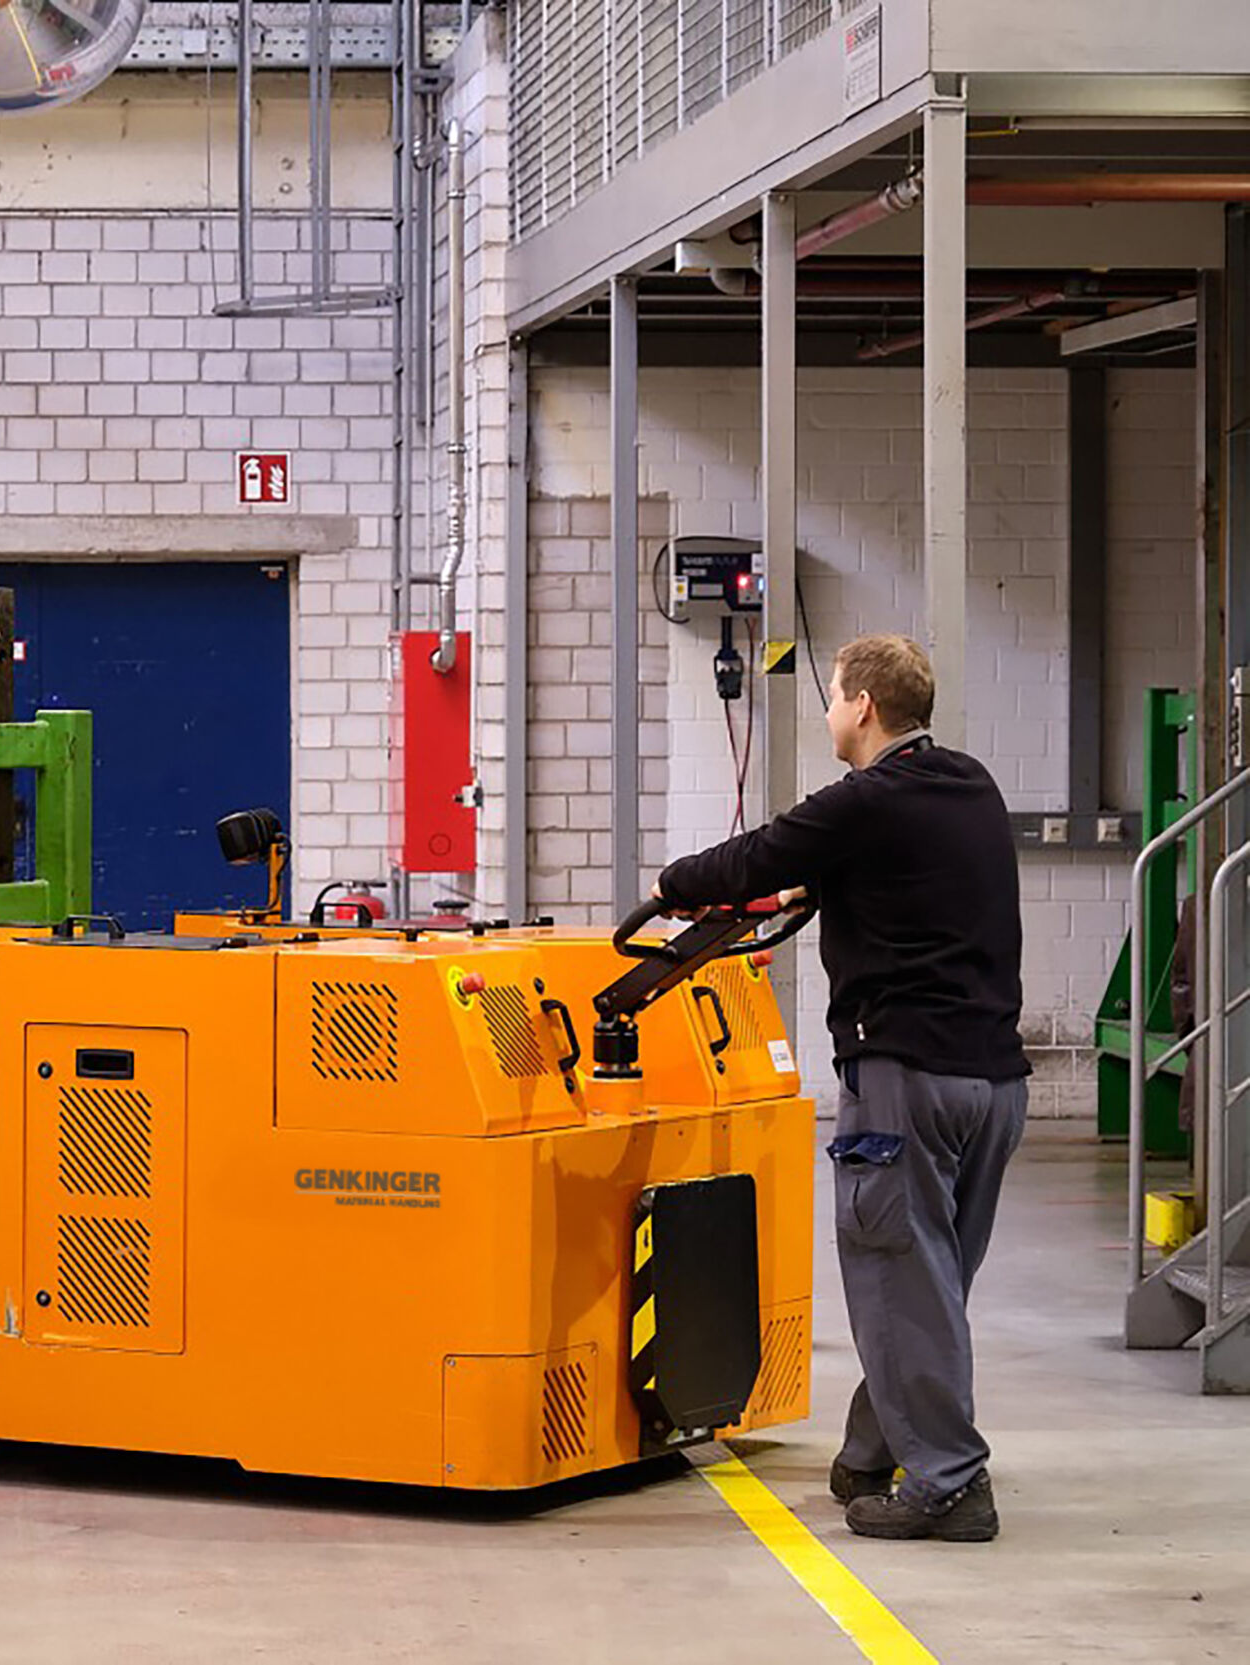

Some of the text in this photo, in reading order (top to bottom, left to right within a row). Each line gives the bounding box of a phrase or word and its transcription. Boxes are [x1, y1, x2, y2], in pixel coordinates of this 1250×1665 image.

[294, 1169, 441, 1193] GENKINGER
[335, 1197, 441, 1208] MATERIAL HANDLING
